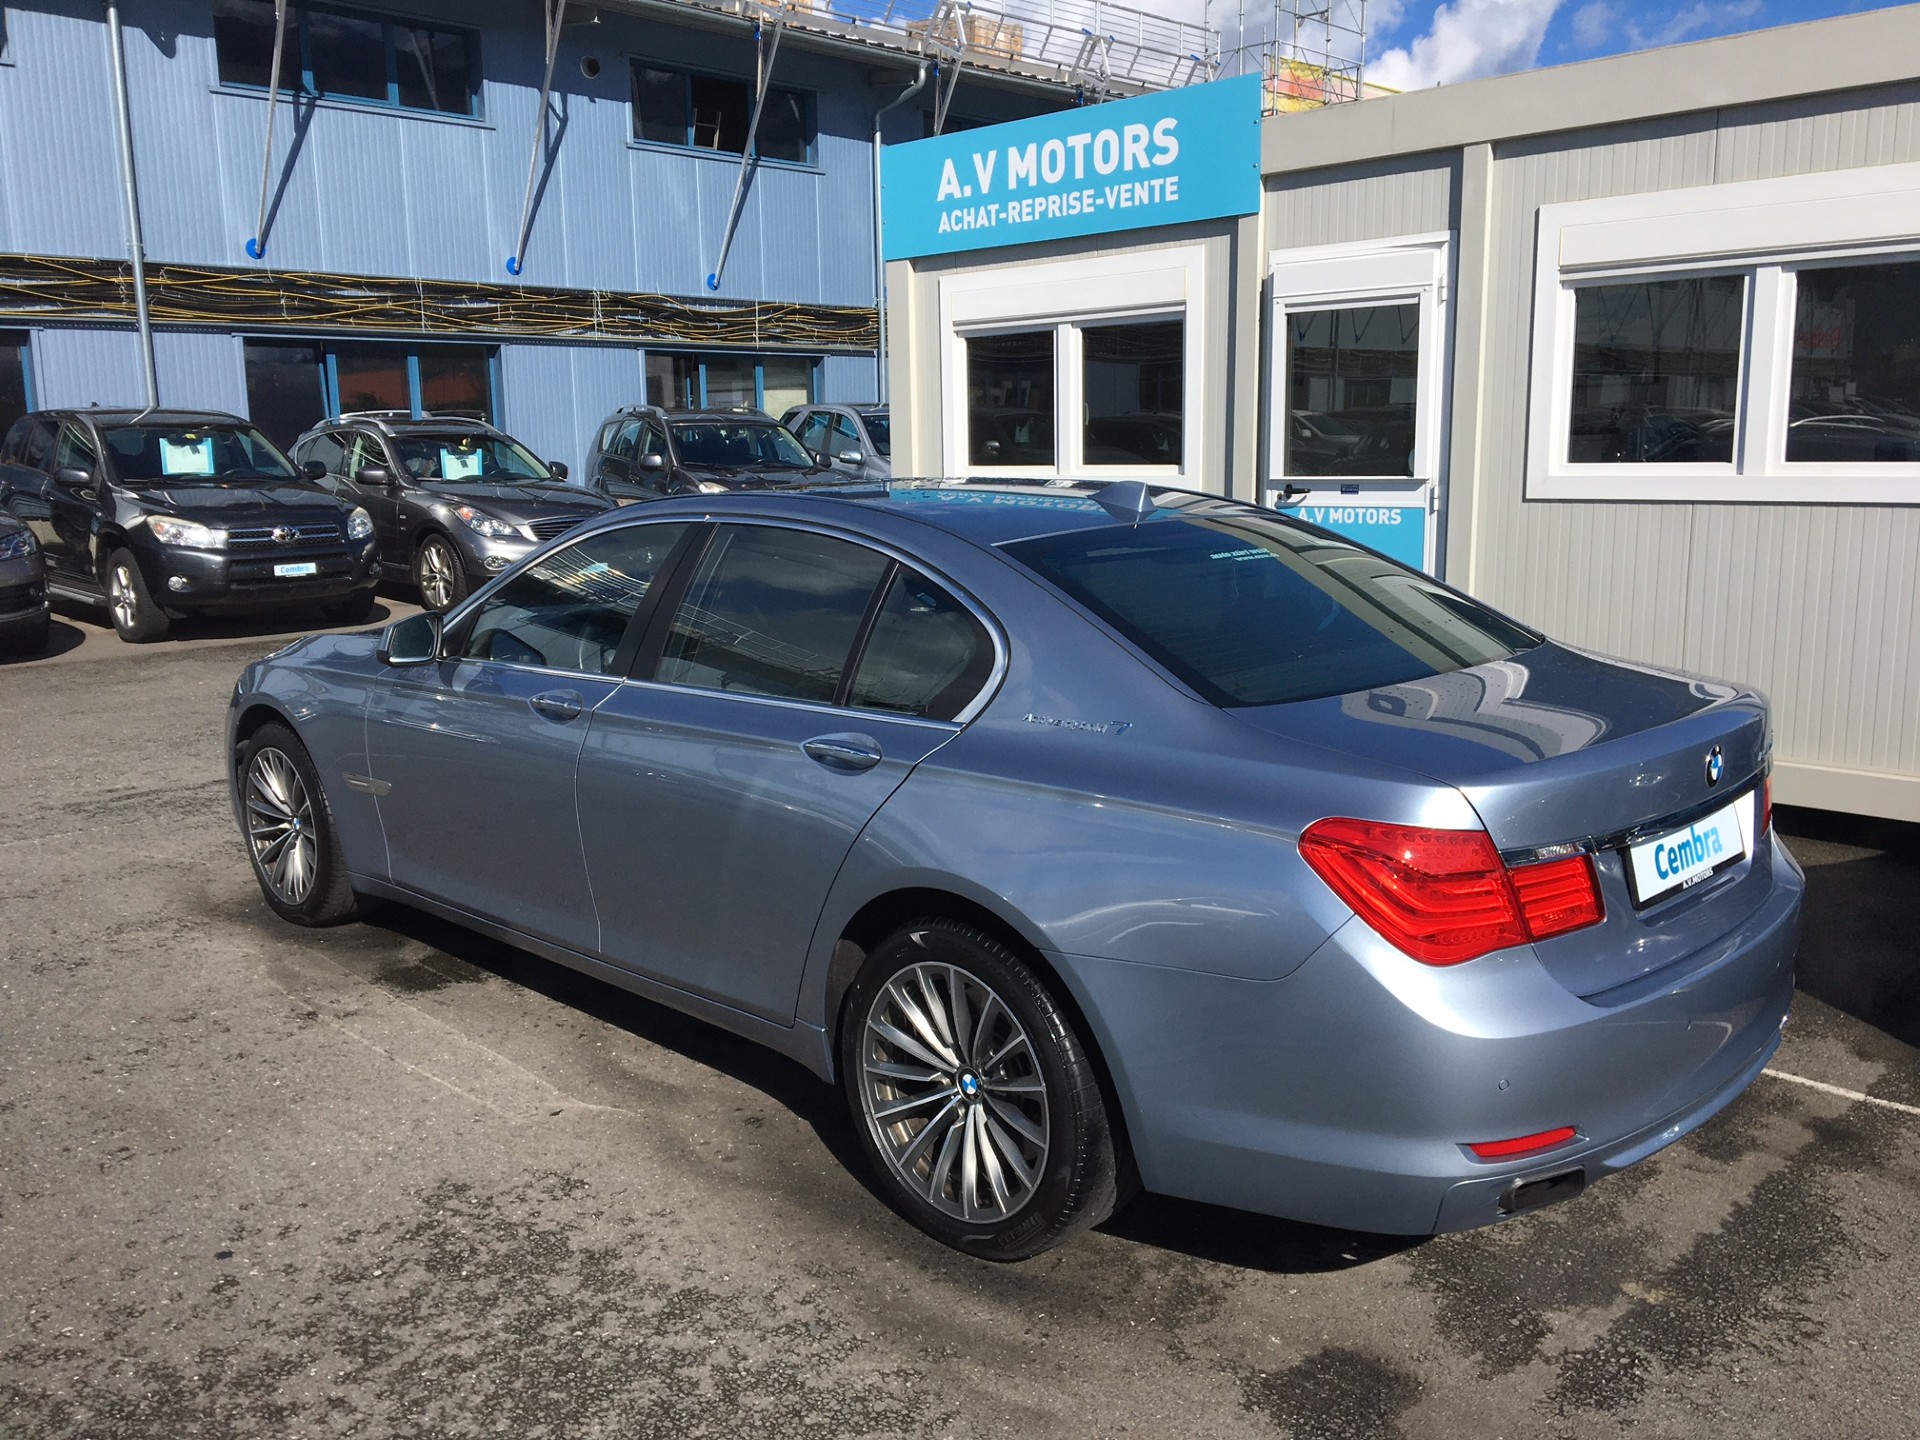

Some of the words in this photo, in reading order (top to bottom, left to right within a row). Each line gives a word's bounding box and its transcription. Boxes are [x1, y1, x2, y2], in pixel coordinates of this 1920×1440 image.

[936, 150, 997, 201] A.V
[1008, 118, 1180, 190] MOTORS
[938, 176, 1179, 233] ACHAT-REPRISE-VENTE
[1299, 508, 1325, 524] A.V
[1330, 508, 1402, 525] MOTORS
[1111, 720, 1133, 735] 7
[1654, 824, 1723, 880] Cembra
